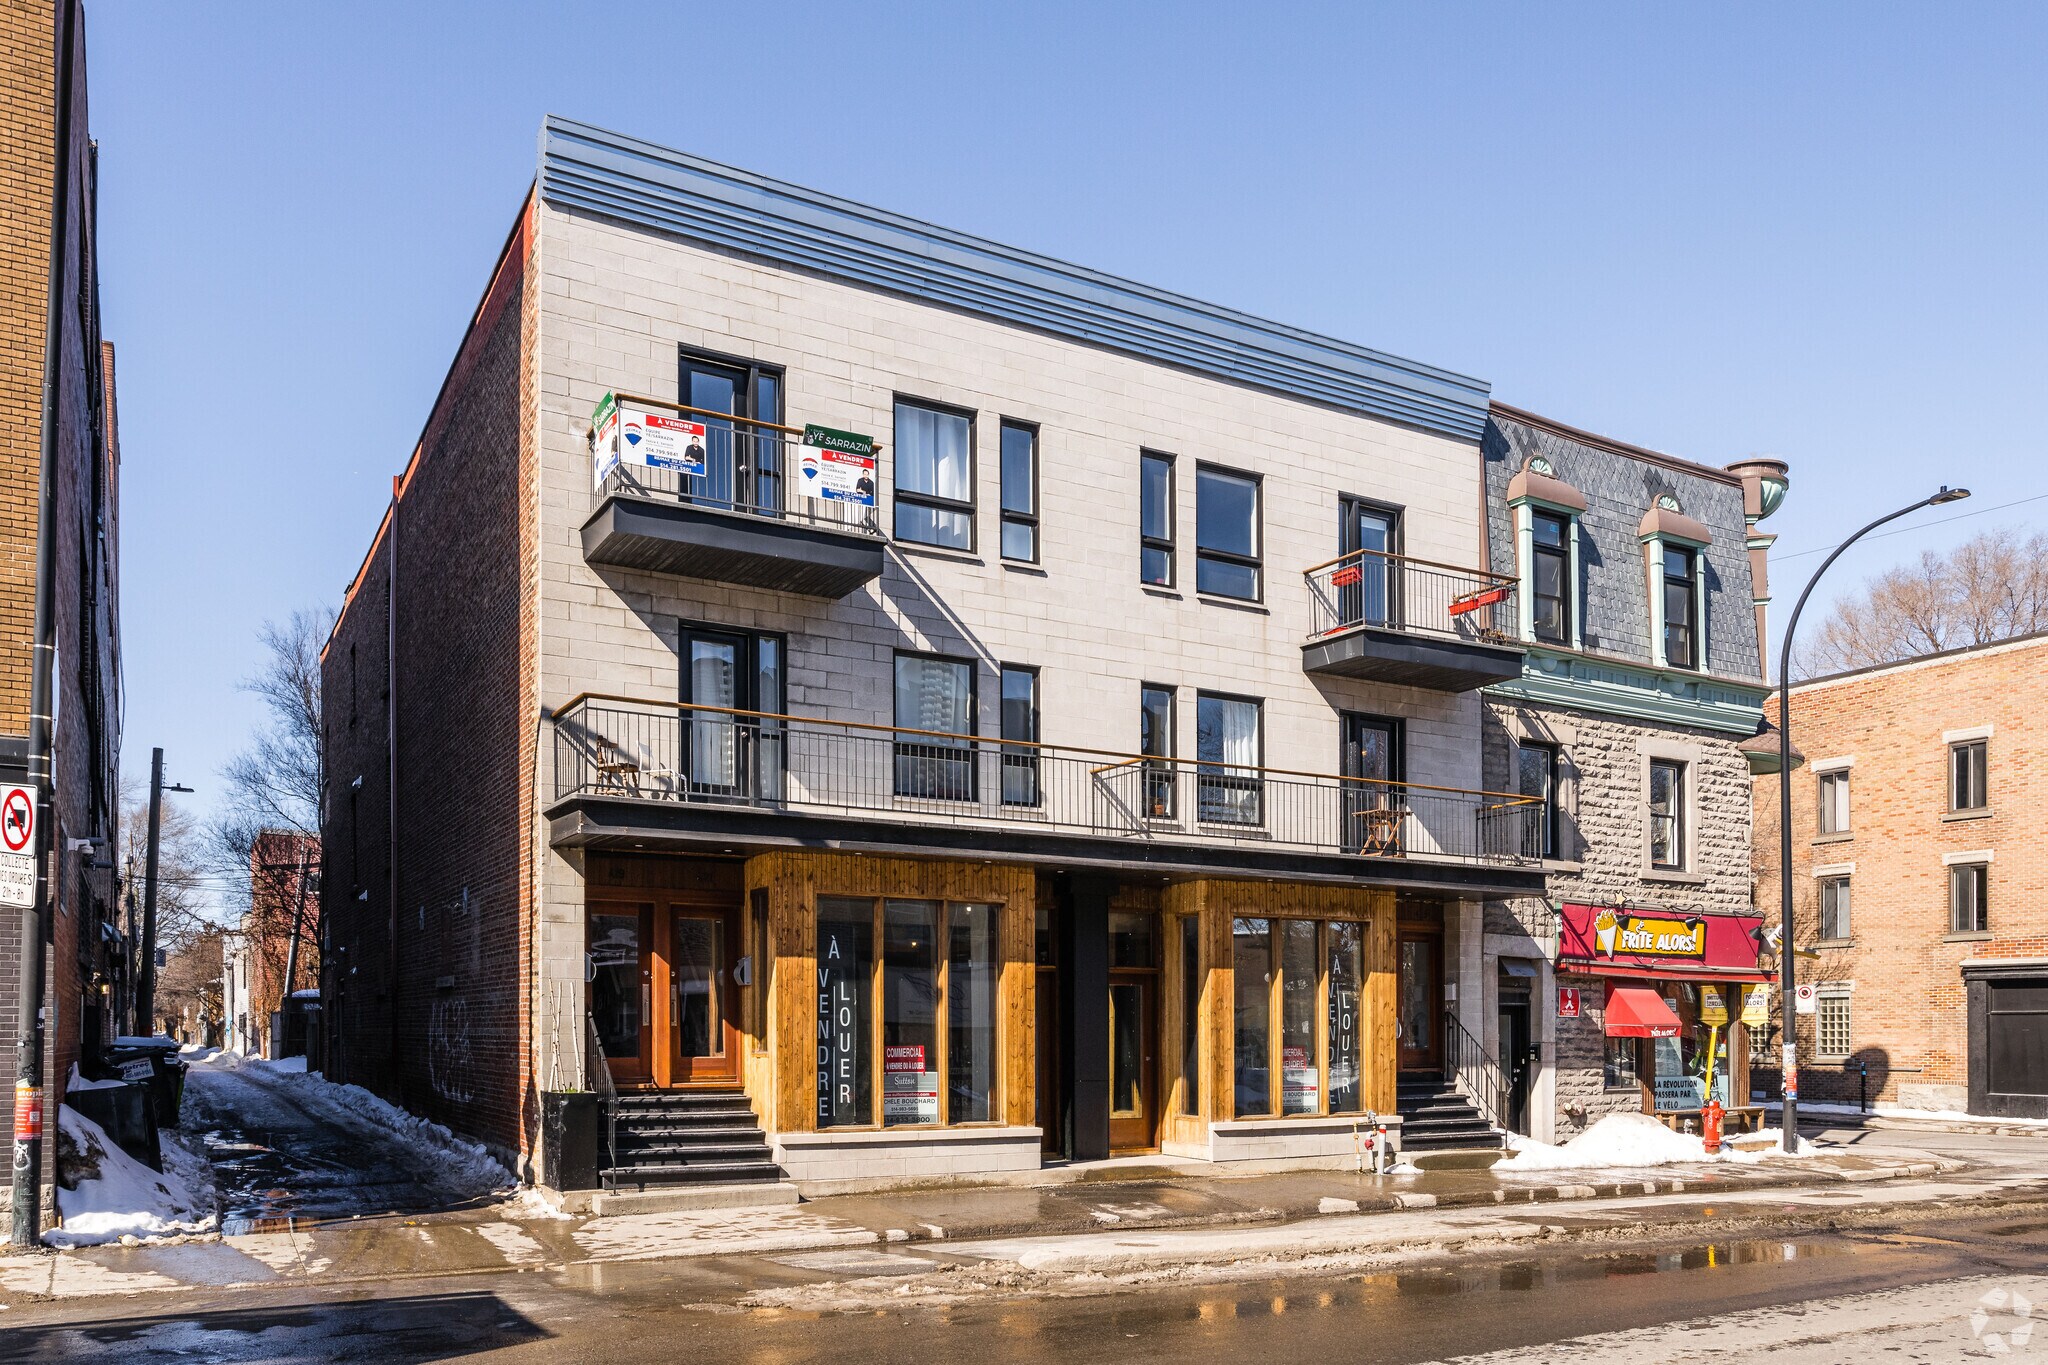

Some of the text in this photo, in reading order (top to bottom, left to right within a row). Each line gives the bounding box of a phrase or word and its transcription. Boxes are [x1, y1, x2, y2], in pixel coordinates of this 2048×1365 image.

[664, 420, 694, 431] VENDRE
[824, 436, 872, 453] SARRAZIN
[838, 454, 864, 463] VENDRE
[1, 854, 30, 870] COLLECTE
[8, 871, 33, 886] ORDURES
[1621, 927, 1698, 952] FRITE ALORS!
[828, 935, 840, 959] À
[818, 968, 829, 1117] VENDRE
[839, 981, 851, 1104] LOUER
[1342, 992, 1351, 1094] LOUER
[886, 1047, 922, 1058] COMMERCIAL
[889, 1062, 903, 1070] VENDRE
[903, 1062, 908, 1070] OU
[911, 1062, 924, 1070] LOUER
[894, 1075, 916, 1085] Sutton
[1663, 1079, 1697, 1089] RÉVOLUTION
[1655, 1090, 1691, 1099] PASSERA PAR
[1655, 1101, 1661, 1109] LE
[1663, 1100, 1679, 1109] VÉLO
